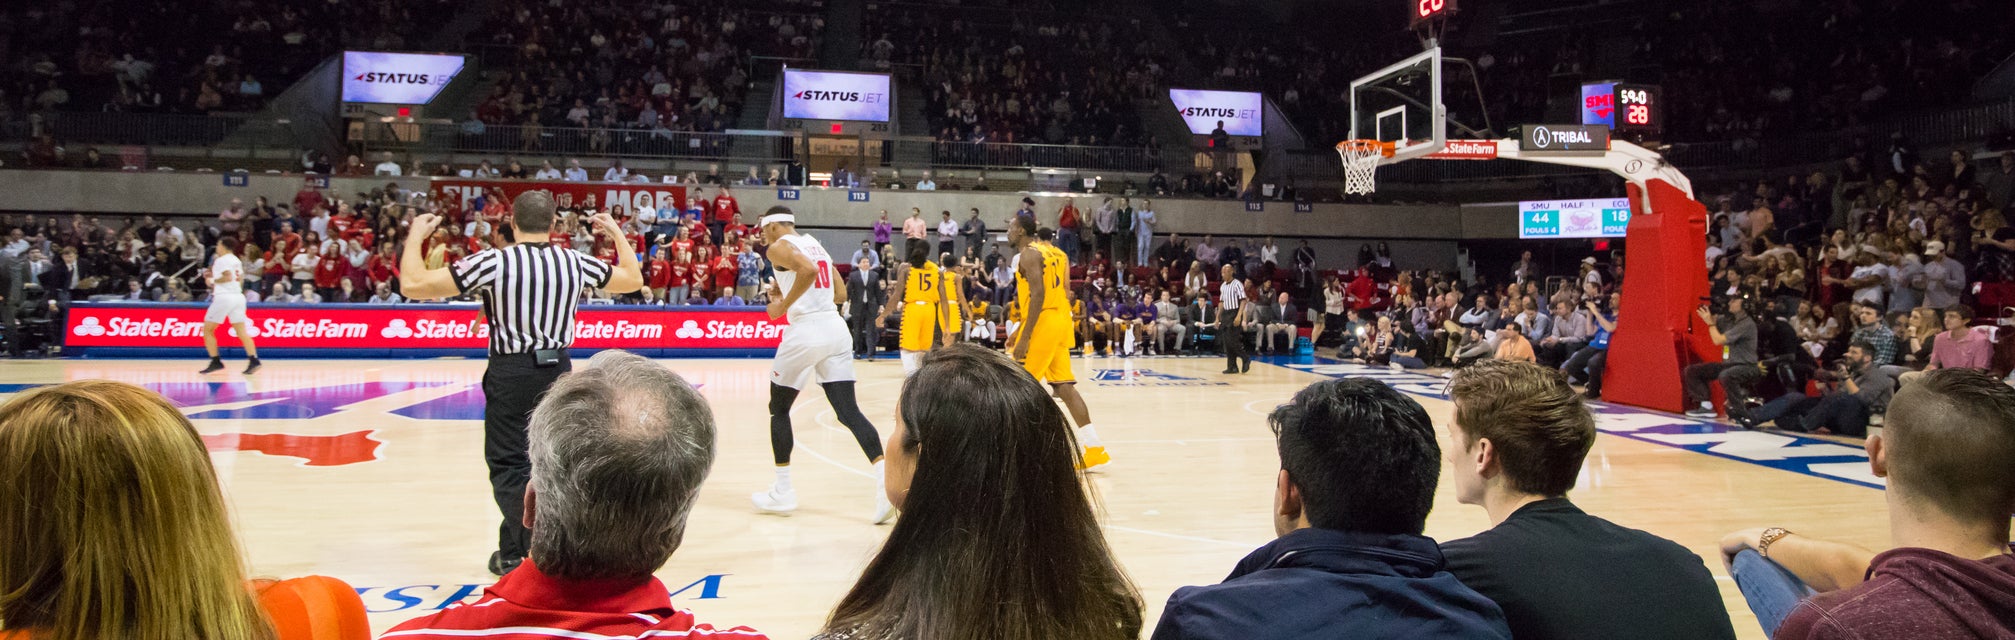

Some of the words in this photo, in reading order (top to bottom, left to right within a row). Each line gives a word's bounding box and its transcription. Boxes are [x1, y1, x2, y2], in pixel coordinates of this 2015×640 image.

[1628, 105, 1648, 124] 28
[1552, 131, 1592, 143] TRIBAL
[783, 190, 796, 199] 112
[852, 192, 866, 200] 113
[1613, 200, 1629, 208] ECU
[1532, 213, 1549, 223] 44
[1612, 211, 1628, 221] 18
[919, 273, 932, 292] 15
[575, 320, 663, 338] tateFarm
